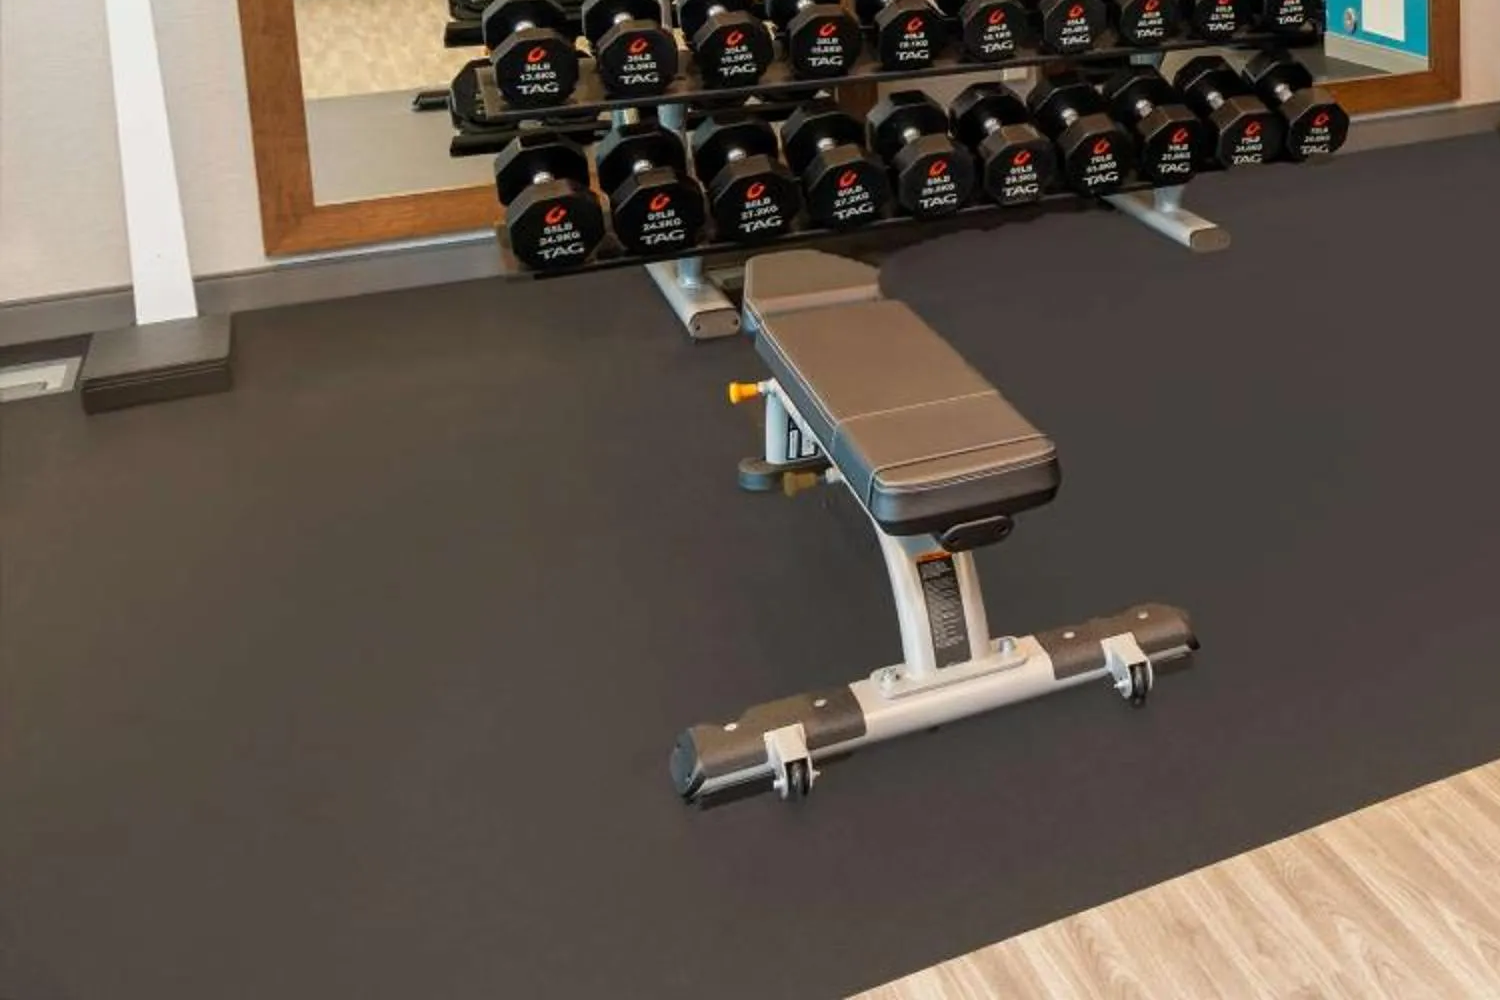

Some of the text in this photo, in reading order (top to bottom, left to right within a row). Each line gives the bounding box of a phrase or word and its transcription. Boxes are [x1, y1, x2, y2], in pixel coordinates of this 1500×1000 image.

[1277, 15, 1303, 24] TAG
[1207, 22, 1235, 31] TAG
[1136, 29, 1164, 38] TAG
[1060, 35, 1090, 45] TAG
[980, 41, 1014, 52] TAG
[808, 55, 843, 67] TAG
[897, 51, 929, 61] TAG
[718, 64, 757, 76] TAG
[619, 72, 659, 84] TAG
[517, 83, 560, 95] TAG
[1232, 154, 1263, 165] TAG
[1158, 163, 1190, 173] TAG
[1083, 171, 1119, 186] TAG
[1002, 183, 1039, 197] TAG
[919, 193, 957, 208] TAG
[832, 202, 874, 220] TAG
[739, 216, 784, 233] TAG
[640, 229, 685, 245] TAG
[537, 242, 585, 260] TAG
